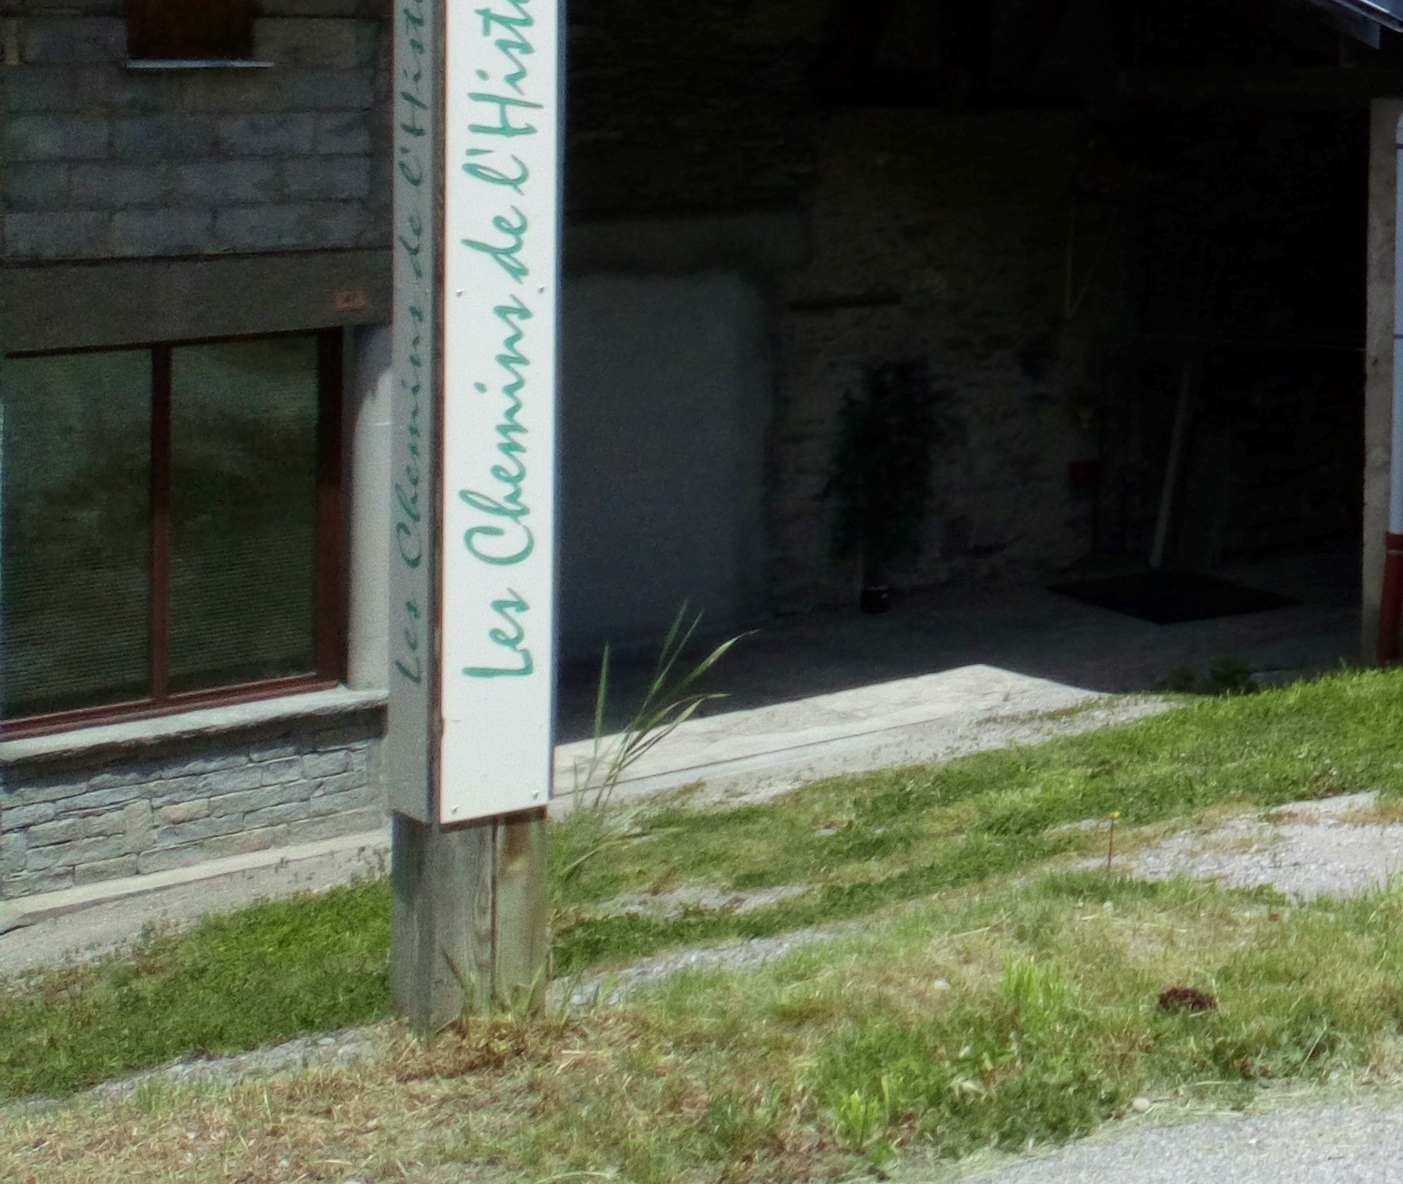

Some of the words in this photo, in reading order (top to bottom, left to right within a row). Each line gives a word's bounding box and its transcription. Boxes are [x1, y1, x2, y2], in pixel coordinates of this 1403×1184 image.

[398, 210, 423, 279] de
[460, 204, 530, 285] de
[395, 303, 424, 570] Chemins
[458, 293, 536, 566] Chemins
[395, 599, 422, 686] Les
[461, 587, 535, 678] Les
